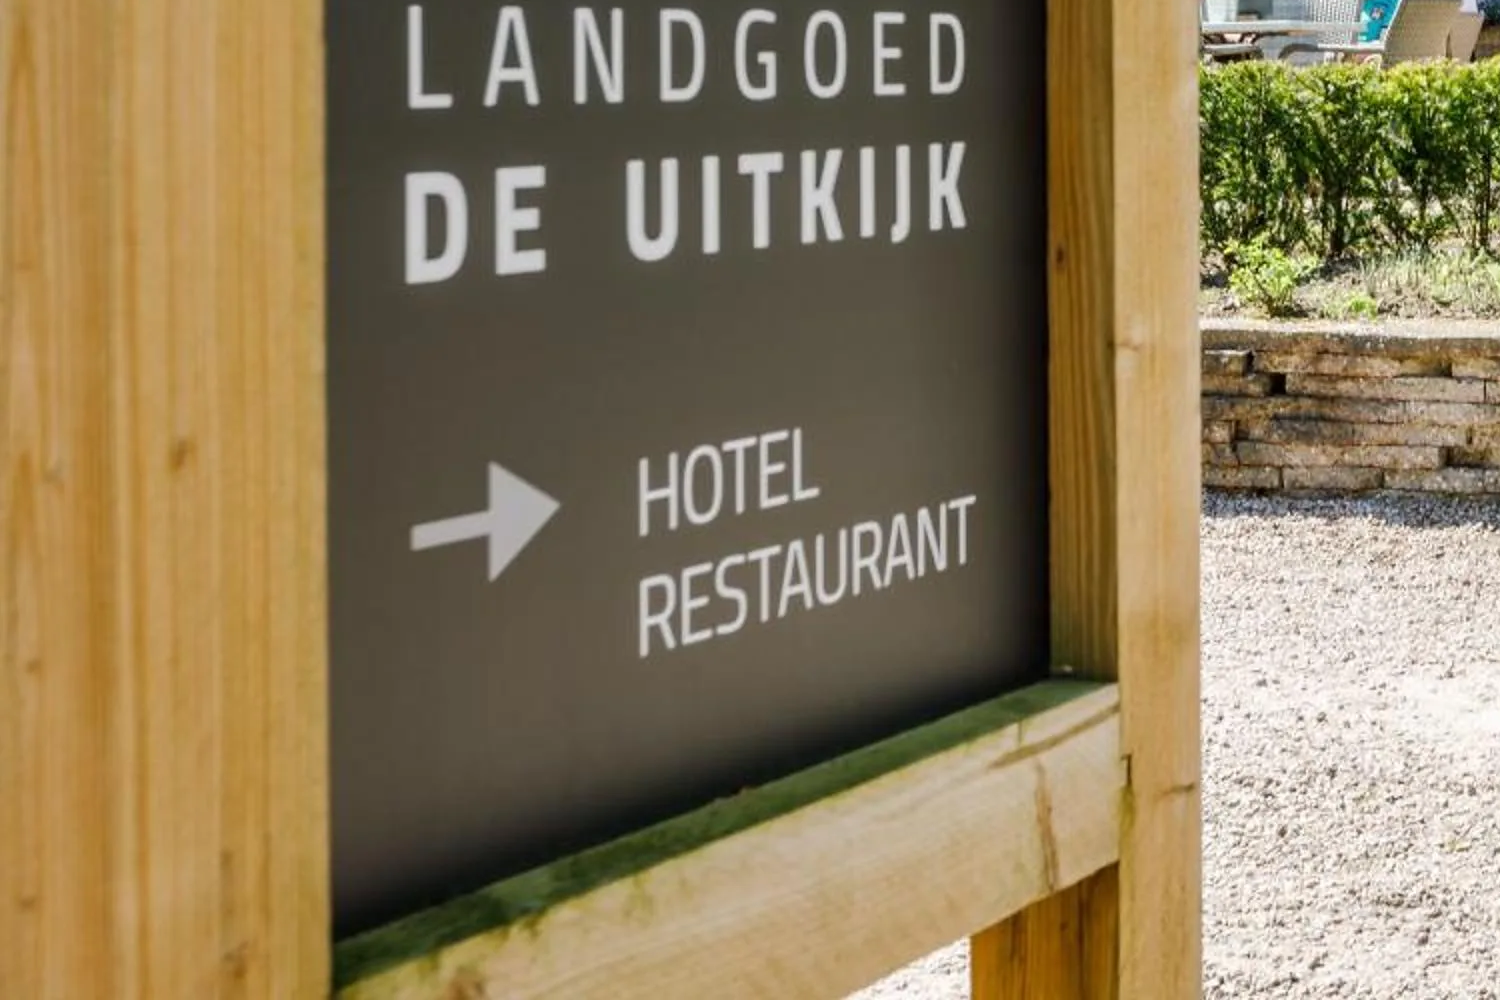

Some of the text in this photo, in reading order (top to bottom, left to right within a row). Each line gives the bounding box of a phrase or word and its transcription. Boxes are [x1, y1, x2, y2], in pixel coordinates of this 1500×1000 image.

[407, 3, 967, 110] LANDGOED
[403, 140, 968, 286] DE UITKIJK
[637, 426, 822, 538] HOTEL
[637, 493, 978, 659] RESTAURANT
